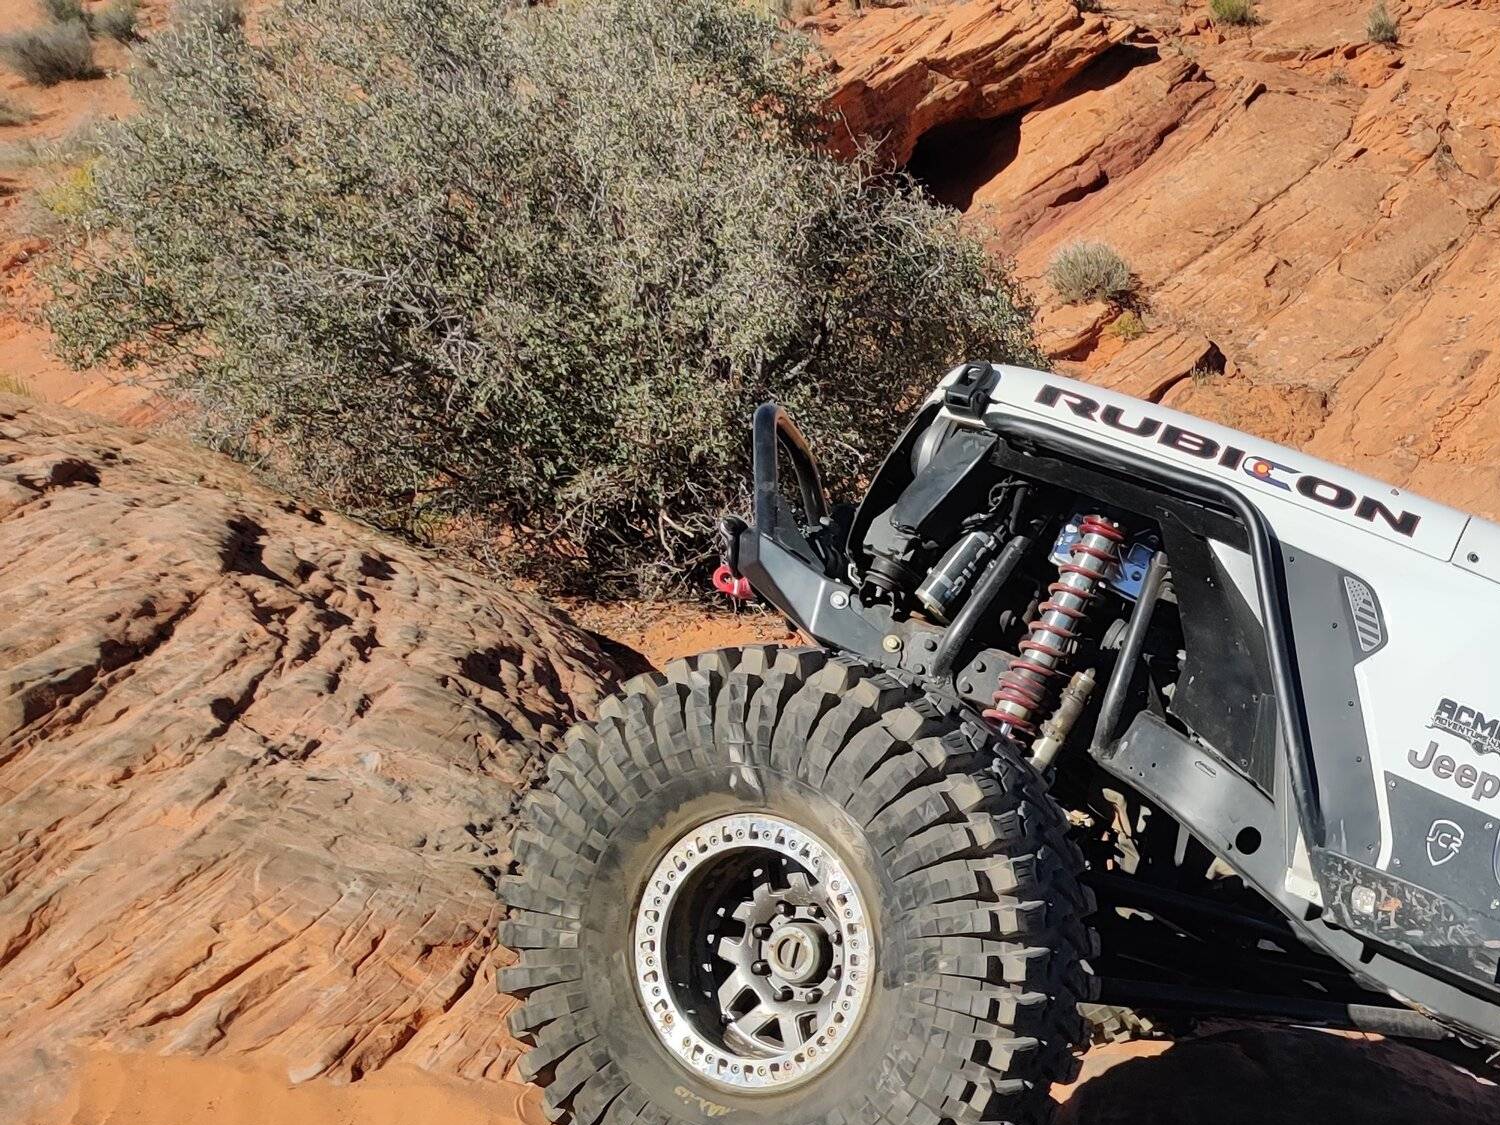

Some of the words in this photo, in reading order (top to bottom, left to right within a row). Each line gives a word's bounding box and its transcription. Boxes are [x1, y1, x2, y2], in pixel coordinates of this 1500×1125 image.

[1034, 383, 1422, 538] RUBICON
[1434, 716, 1489, 744] ADVENTURE
[1407, 740, 1500, 801] Jeep
[1426, 828, 1463, 854] JCR
